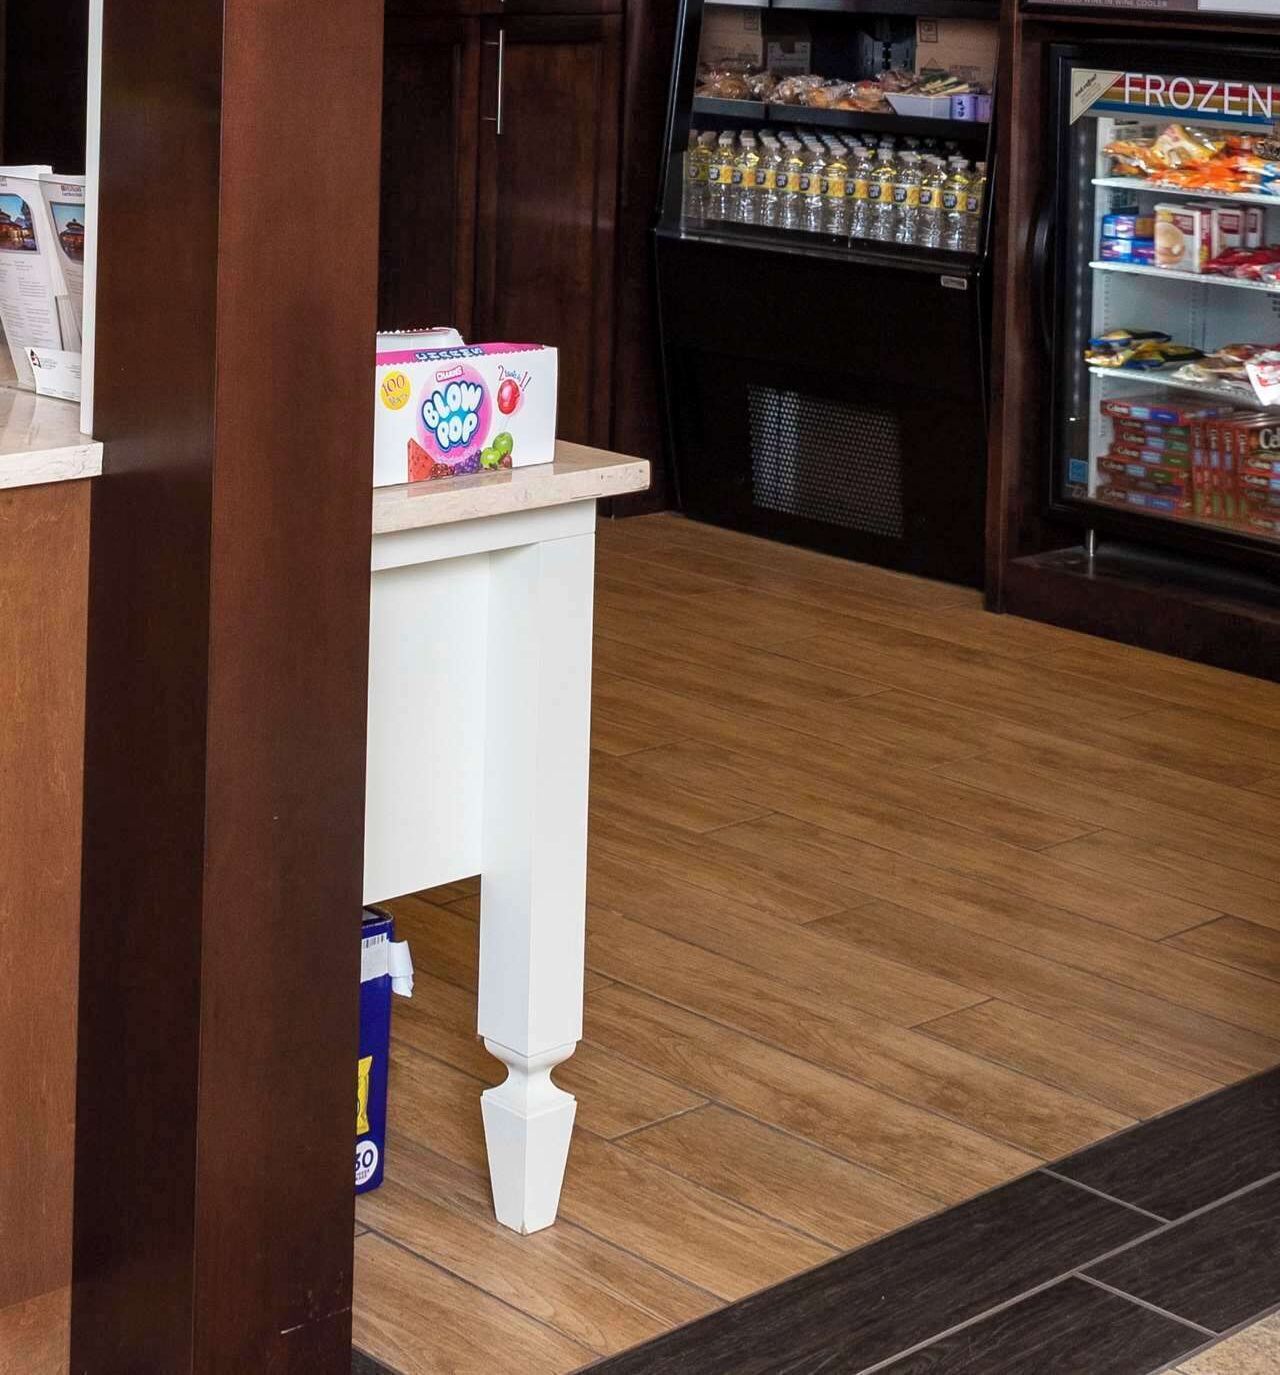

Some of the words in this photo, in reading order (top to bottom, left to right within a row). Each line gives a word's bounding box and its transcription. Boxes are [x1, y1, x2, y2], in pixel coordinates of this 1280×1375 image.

[1136, 0, 1168, 7] COOLER
[1124, 72, 1273, 119] FROZEN
[381, 374, 406, 397] 100
[436, 366, 464, 383] CHARMS
[422, 380, 483, 430] BLOW
[435, 411, 479, 452] POP
